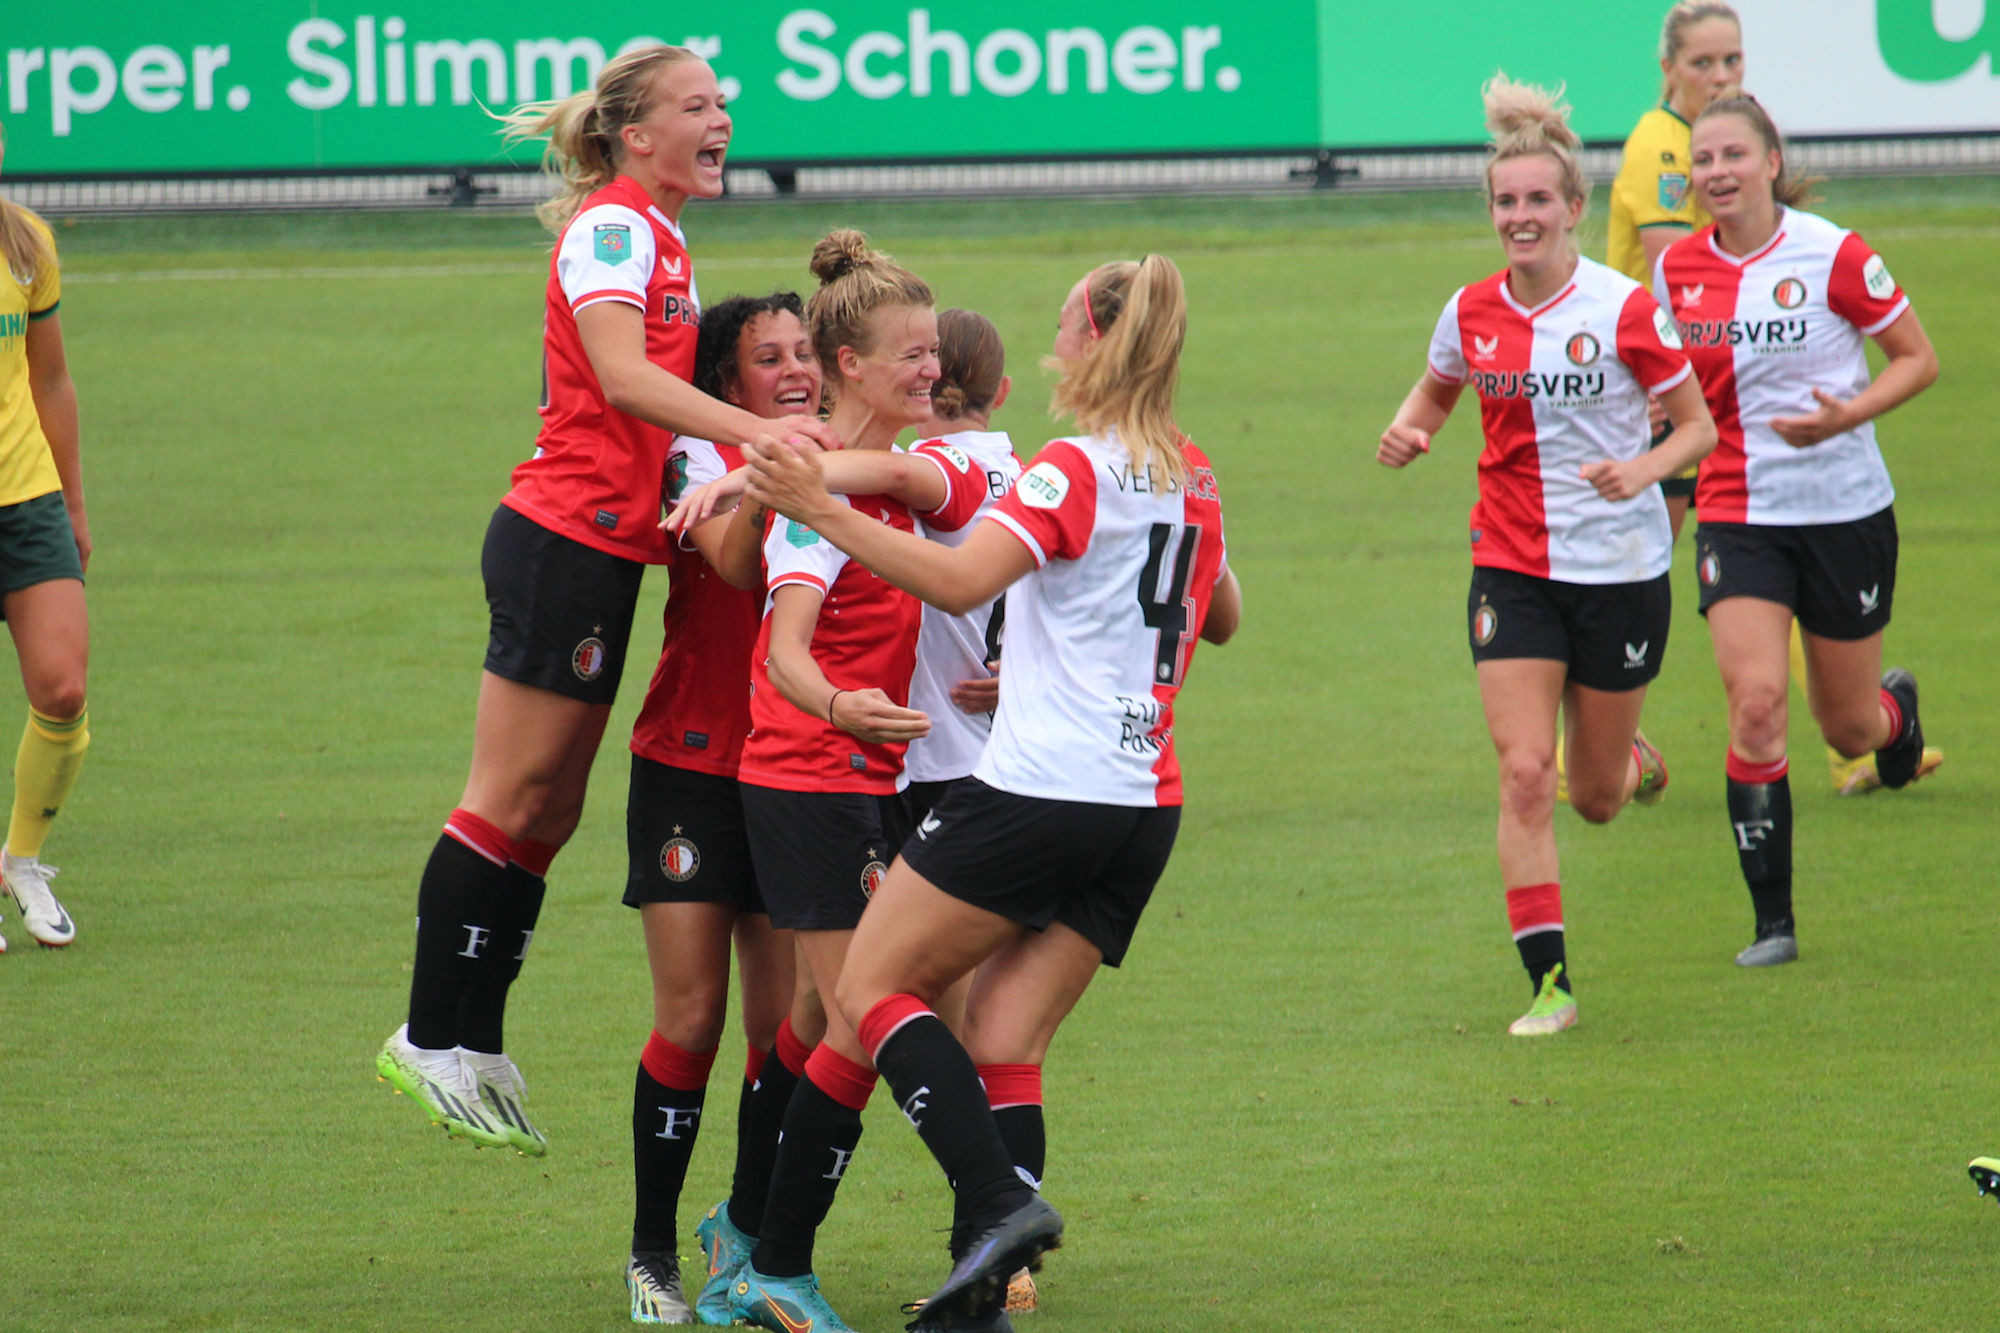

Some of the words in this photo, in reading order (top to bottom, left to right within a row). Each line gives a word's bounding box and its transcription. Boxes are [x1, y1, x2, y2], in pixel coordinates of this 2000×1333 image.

[286, 14, 742, 110] Slimmr.
[775, 8, 1241, 100] Schoner.
[1024, 472, 1061, 502] TOTO
[1137, 521, 1203, 688] 4
[1734, 819, 1775, 851] F
[457, 924, 490, 959] F
[655, 1105, 701, 1140] F
